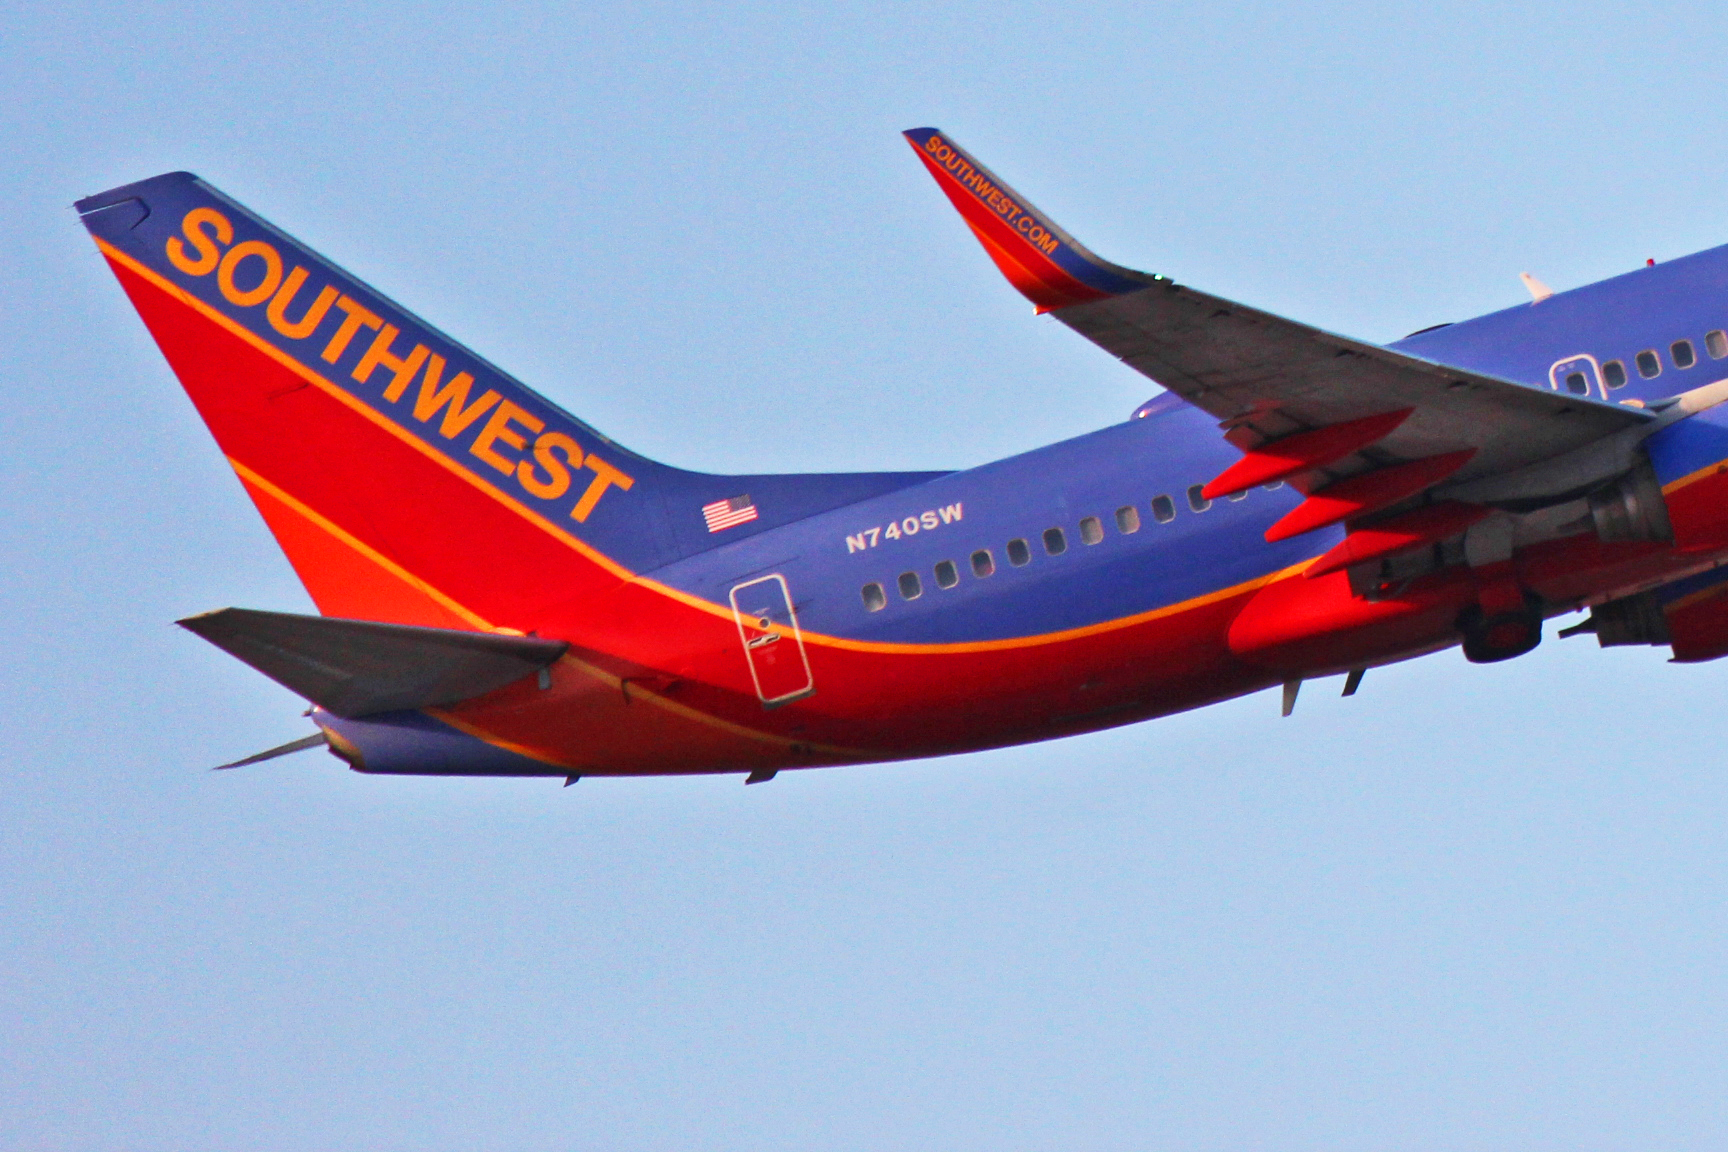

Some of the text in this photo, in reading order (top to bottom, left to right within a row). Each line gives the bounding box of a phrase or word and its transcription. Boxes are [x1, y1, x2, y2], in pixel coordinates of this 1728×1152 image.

[925, 135, 1058, 254] SOUTHWEST.COM
[165, 207, 634, 523] SOUTHWEST
[846, 501, 962, 554] N740SW
